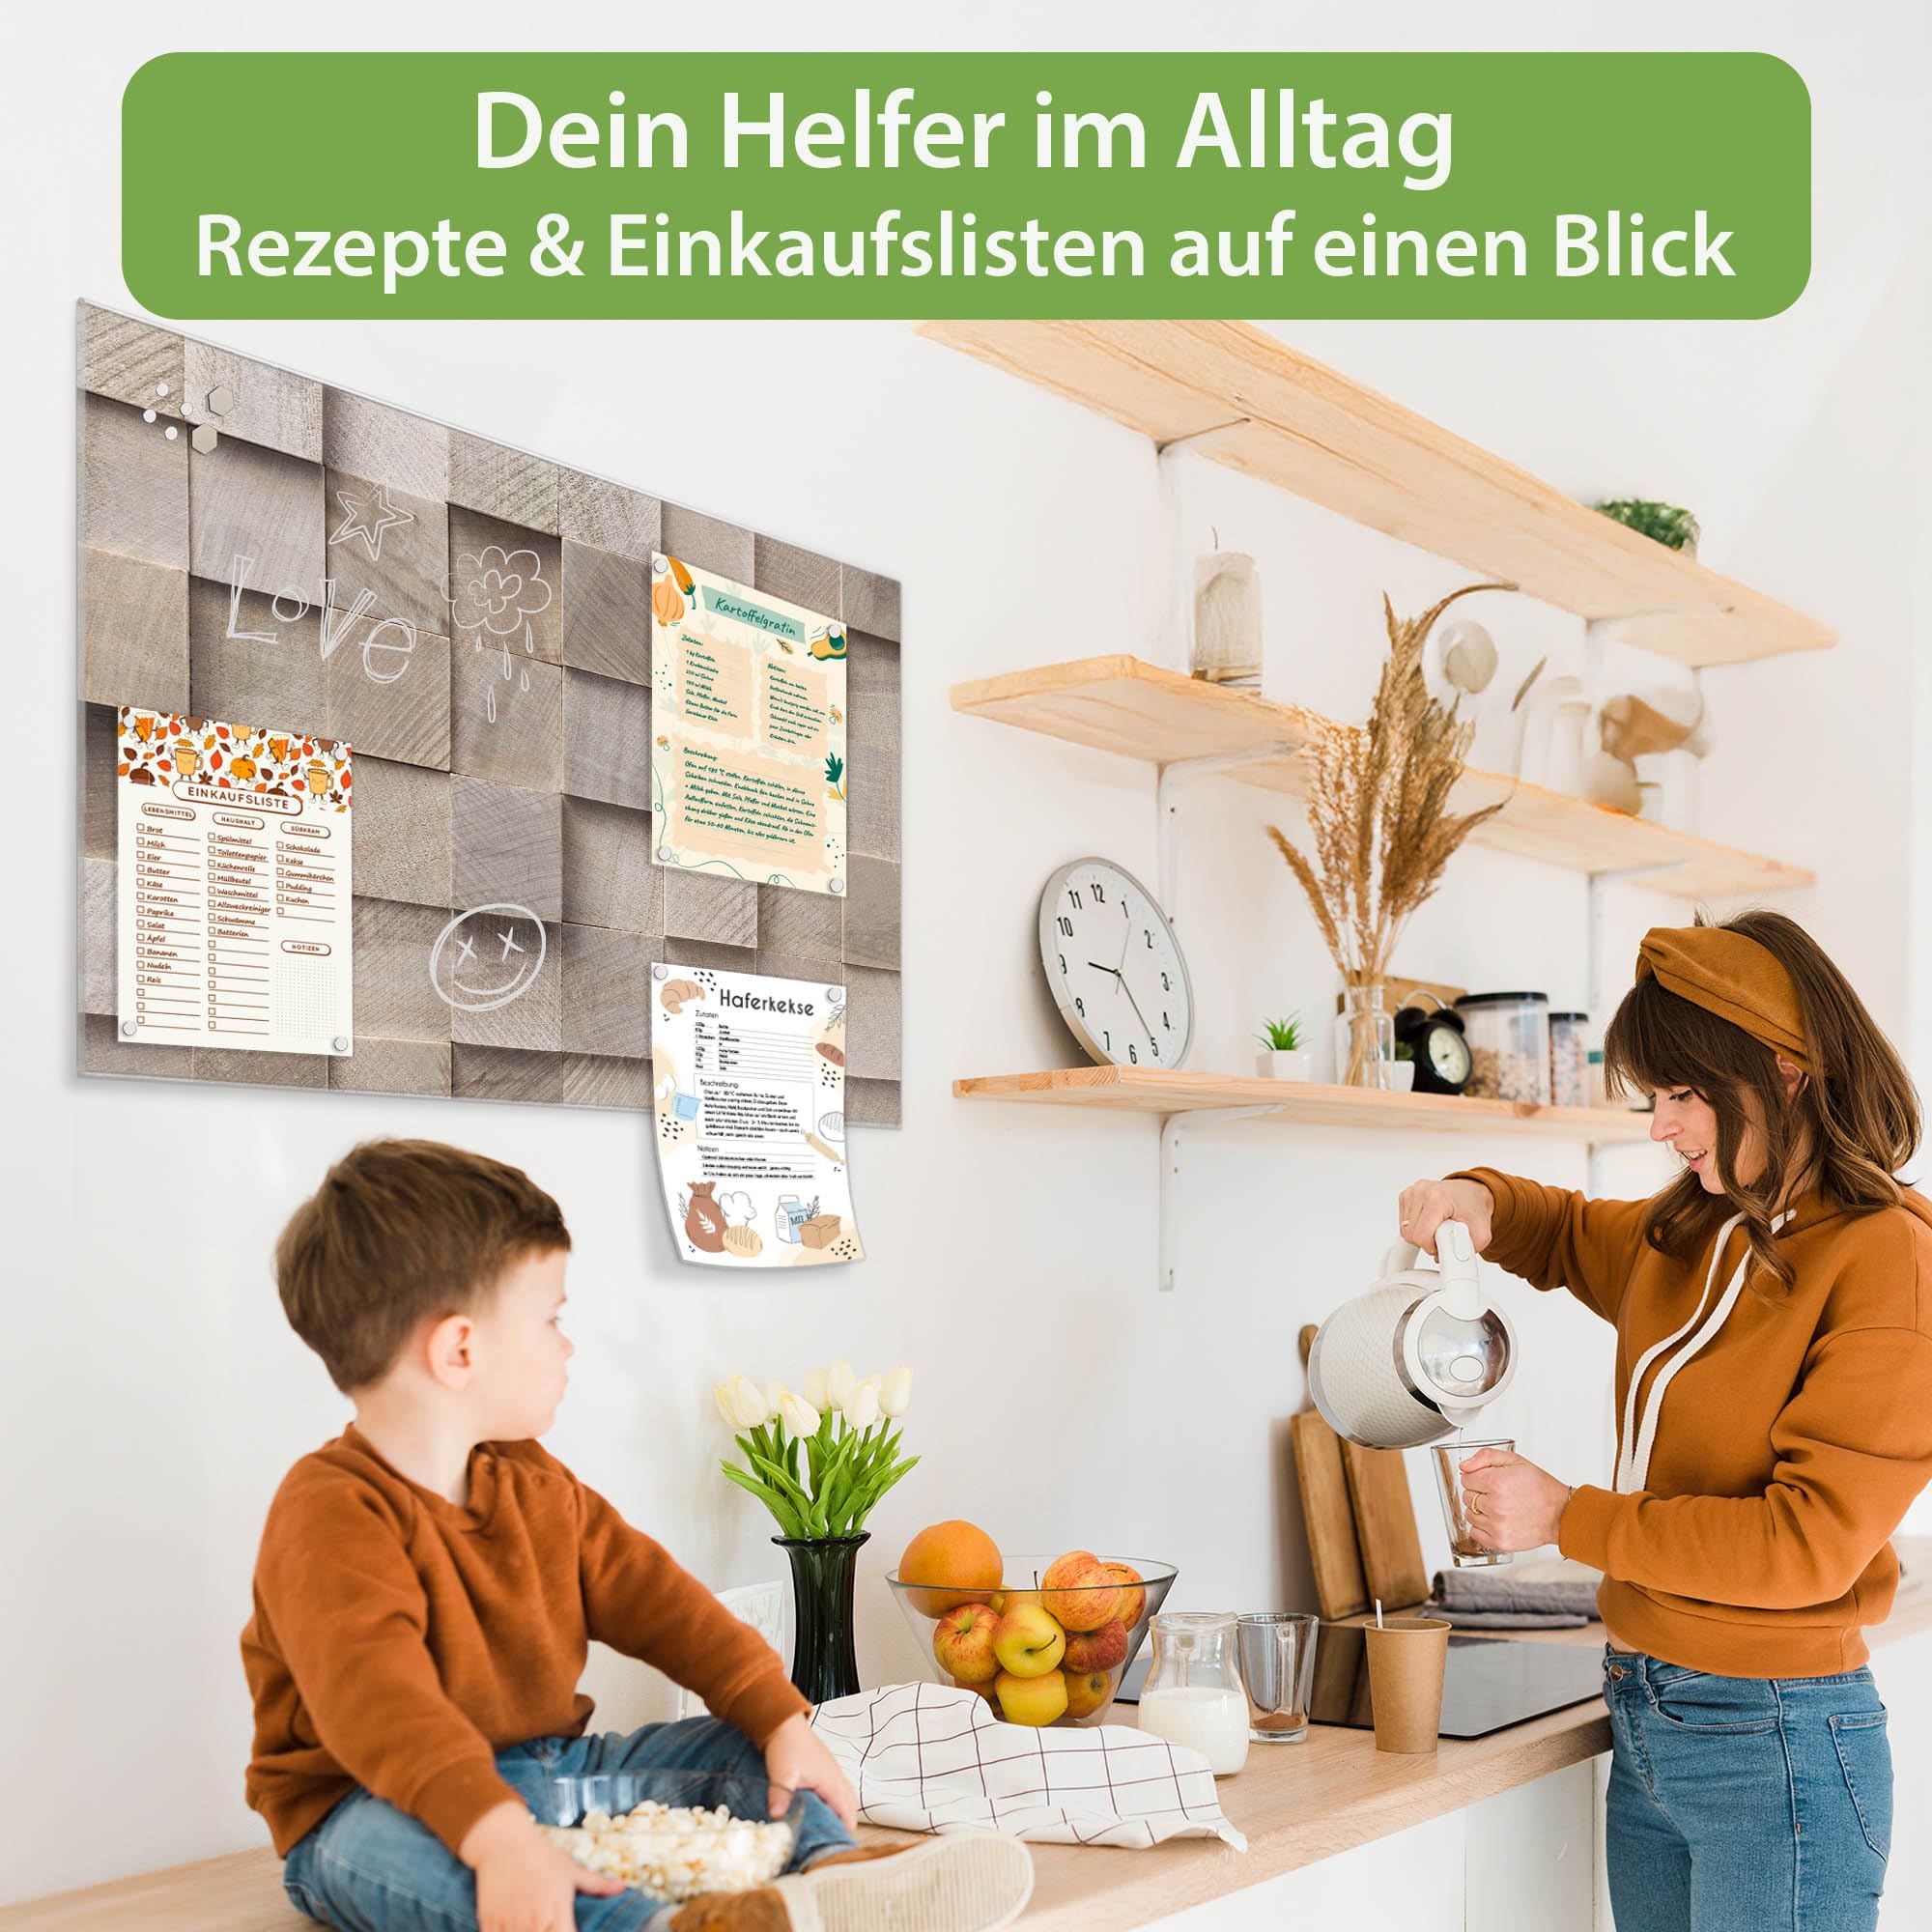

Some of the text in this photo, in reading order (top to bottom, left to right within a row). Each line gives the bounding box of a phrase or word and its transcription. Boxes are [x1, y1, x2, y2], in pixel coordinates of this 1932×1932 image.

[715, 597, 796, 636] Kartoffelgratin
[187, 786, 289, 810] EINKAUFSLISTE
[144, 806, 193, 818] LEBENSMITTEL
[221, 816, 256, 826] HAUSHALT
[147, 825, 163, 834] Brot
[216, 835, 252, 845] Spülmittel
[286, 843, 321, 854] Schokolade
[217, 849, 268, 861] Toilettenpapier
[217, 862, 256, 872] Küchenrolle
[217, 875, 251, 885] Müllbeutel
[286, 870, 334, 882] Gummibärchen
[217, 888, 259, 898] Waschmittel
[286, 883, 313, 894] Pudding
[1091, 884, 1105, 903] 12
[147, 895, 179, 903] Karotten
[1068, 890, 1083, 910] 11
[147, 907, 174, 918] Paprika
[1121, 900, 1128, 919] 1
[147, 921, 165, 929] Salat
[1057, 916, 1073, 937] 10
[217, 928, 249, 937] Batterien
[1144, 929, 1153, 950] 2
[147, 948, 178, 957] Bananen
[147, 962, 172, 971] Nudeln
[1059, 953, 1067, 975] 9
[147, 976, 162, 984] Reis
[1161, 972, 1170, 991] 3
[720, 988, 814, 1016] Haferkekse
[1075, 997, 1085, 1017] 8
[1163, 1011, 1170, 1031] 4
[1103, 1031, 1110, 1052] 7
[1151, 1037, 1159, 1057] 5
[1128, 1044, 1137, 1065] 6
